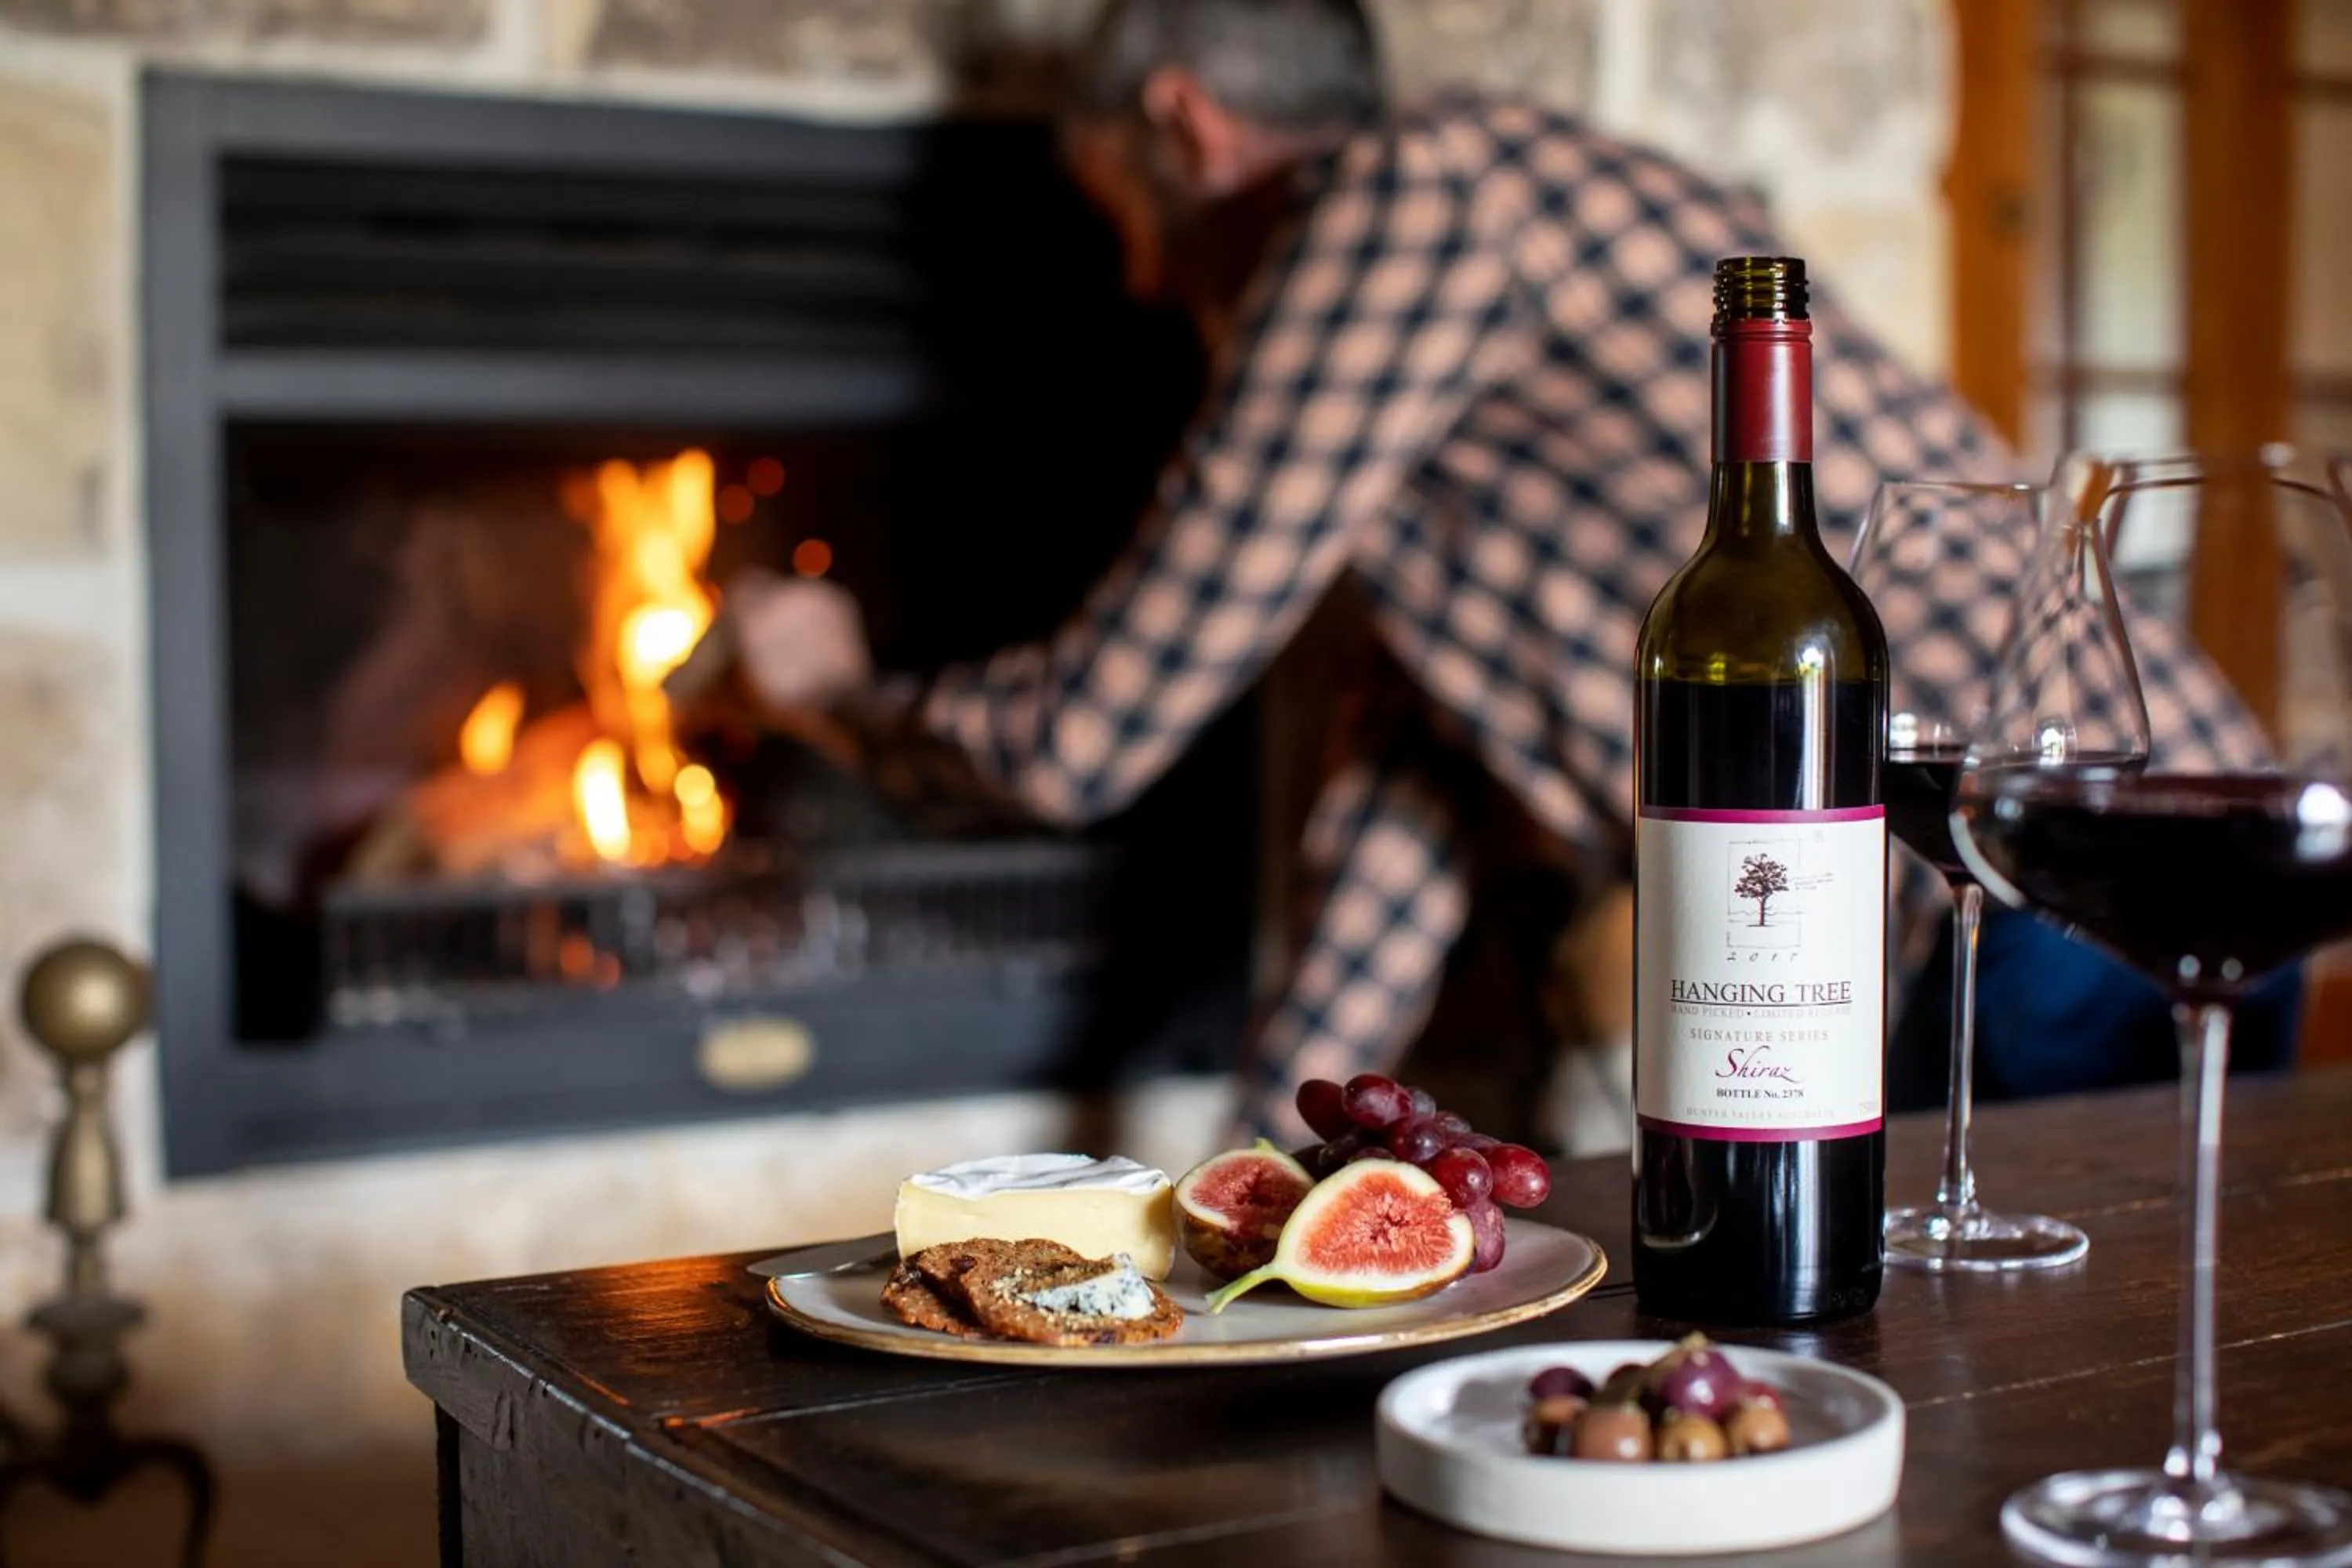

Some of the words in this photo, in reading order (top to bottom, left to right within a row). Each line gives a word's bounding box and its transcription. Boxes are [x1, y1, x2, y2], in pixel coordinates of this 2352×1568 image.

[1671, 980, 1785, 1003] HANGING
[1795, 982, 1851, 1002] TREE
[1690, 1028, 1773, 1042] SIGNATURE
[1780, 1029, 1829, 1042] SERIES
[1715, 1045, 1804, 1084] Shiraz
[1716, 1088, 1760, 1098] BOTTLE
